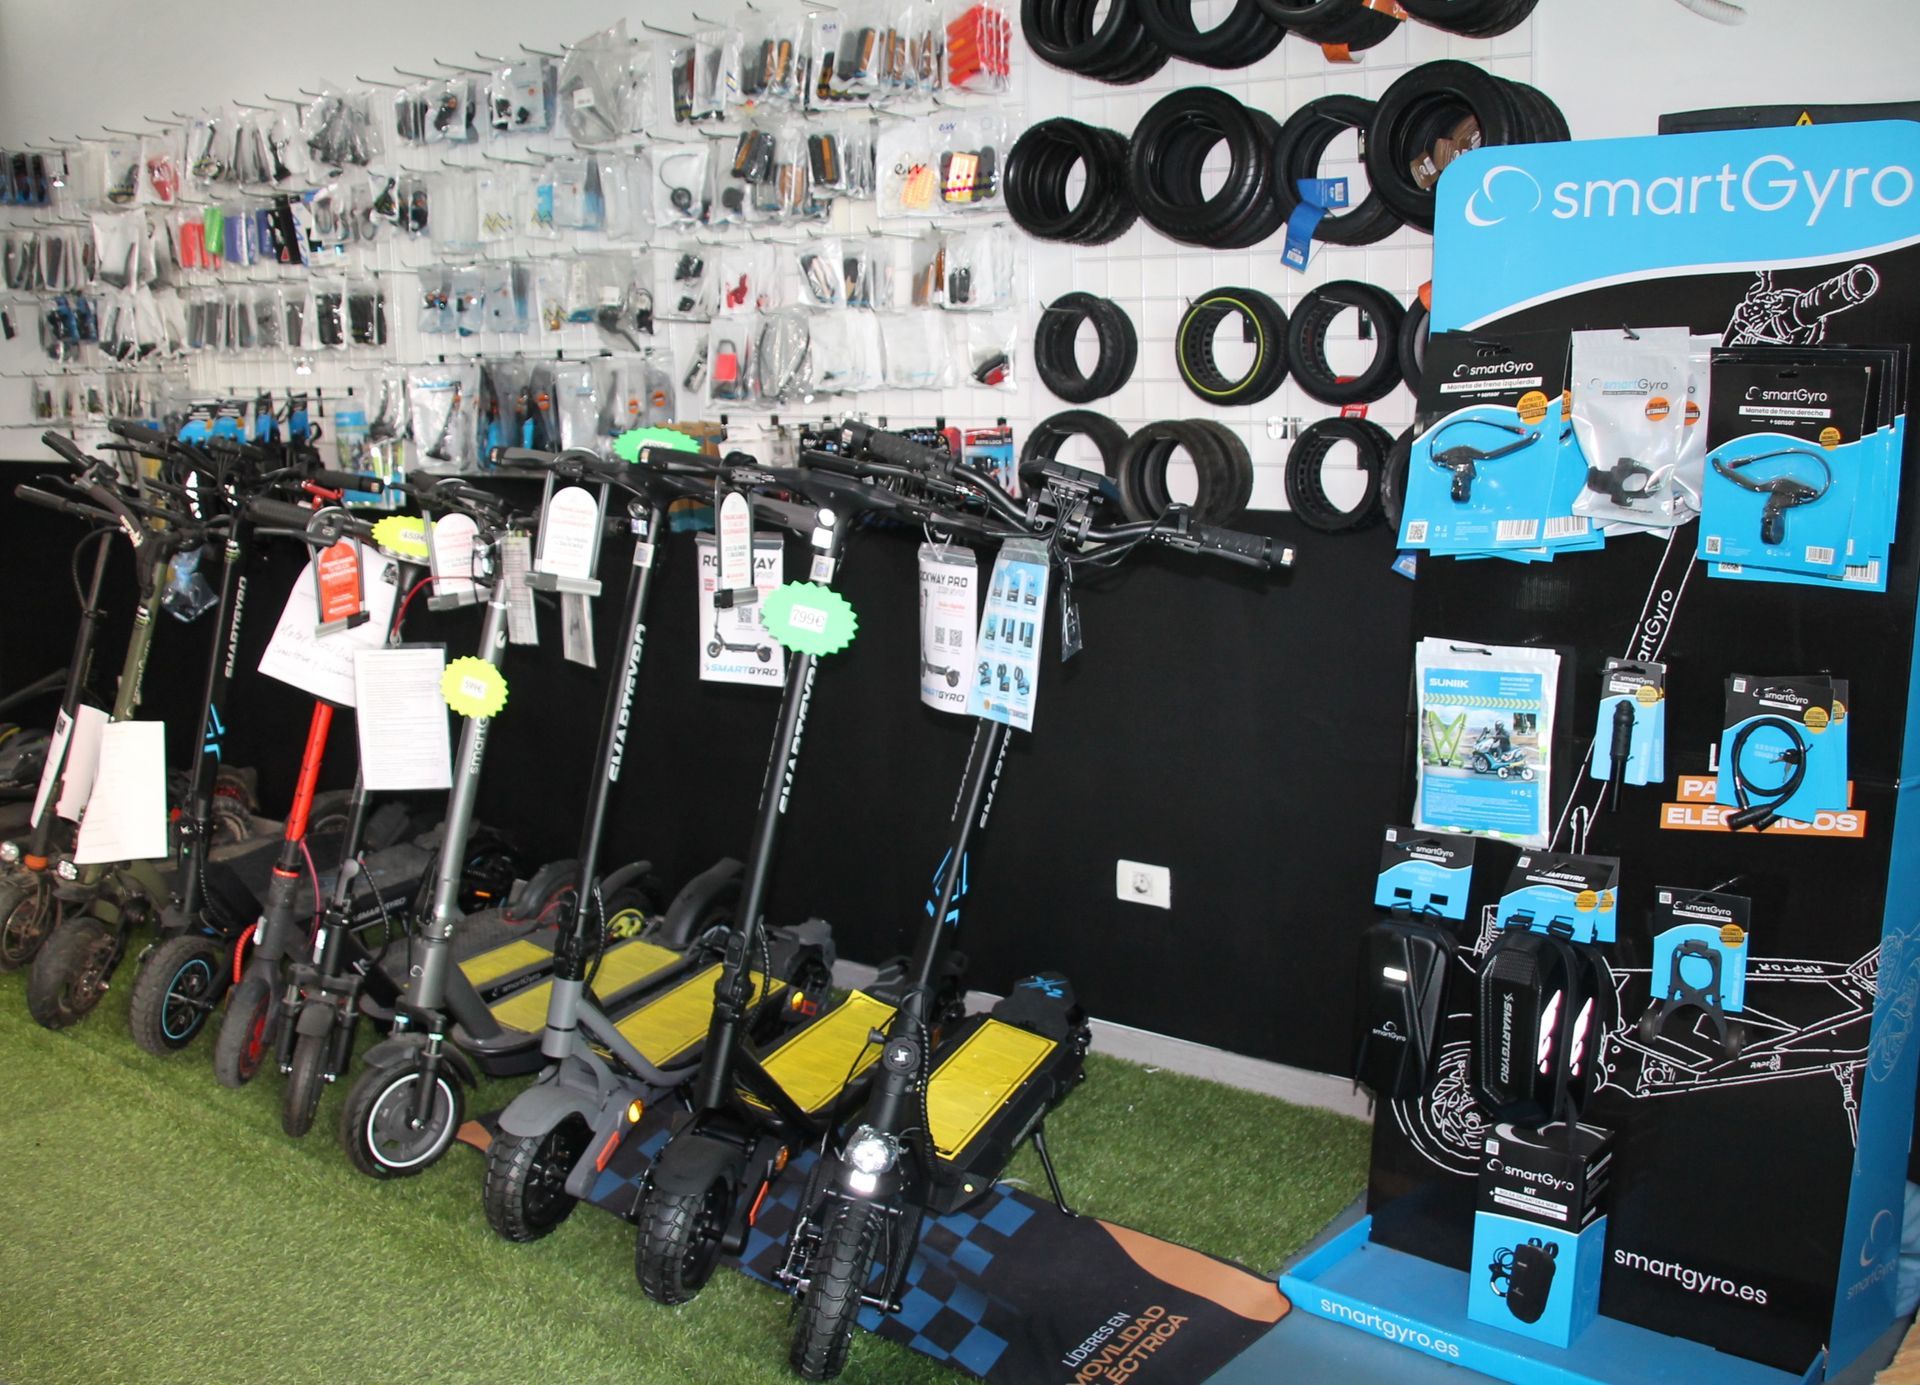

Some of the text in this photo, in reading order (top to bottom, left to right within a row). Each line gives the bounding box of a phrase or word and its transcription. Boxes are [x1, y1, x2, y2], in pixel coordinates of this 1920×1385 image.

[1552, 154, 1913, 226] smartGyro
[1470, 361, 1534, 375] smartGyro
[1603, 378, 1668, 391] smartGyro
[1762, 388, 1828, 404] smartGyro
[947, 576, 968, 588] PRO
[224, 575, 248, 679] SMARTGYRO
[793, 608, 825, 628] 799€
[1637, 589, 1673, 661] artGyro
[710, 663, 778, 677] SMARTGYRO
[1620, 675, 1655, 686] smartGyro
[608, 622, 647, 782] SMARTGYRO
[1763, 692, 1809, 705] smartGyro
[470, 717, 488, 775] smartG
[1415, 846, 1454, 858] smartGyro
[1685, 903, 1732, 916] smartGyro
[1373, 1028, 1407, 1042] smartGyro
[1501, 1000, 1513, 1085] SMARTGYRO
[1504, 1165, 1575, 1192] smartGyro
[1523, 1186, 1537, 1195] KIT
[1614, 1249, 1767, 1304] smartgyro.es
[1320, 1299, 1459, 1357] smartgyro.es
[1062, 1311, 1132, 1367] LÍDERES EN
